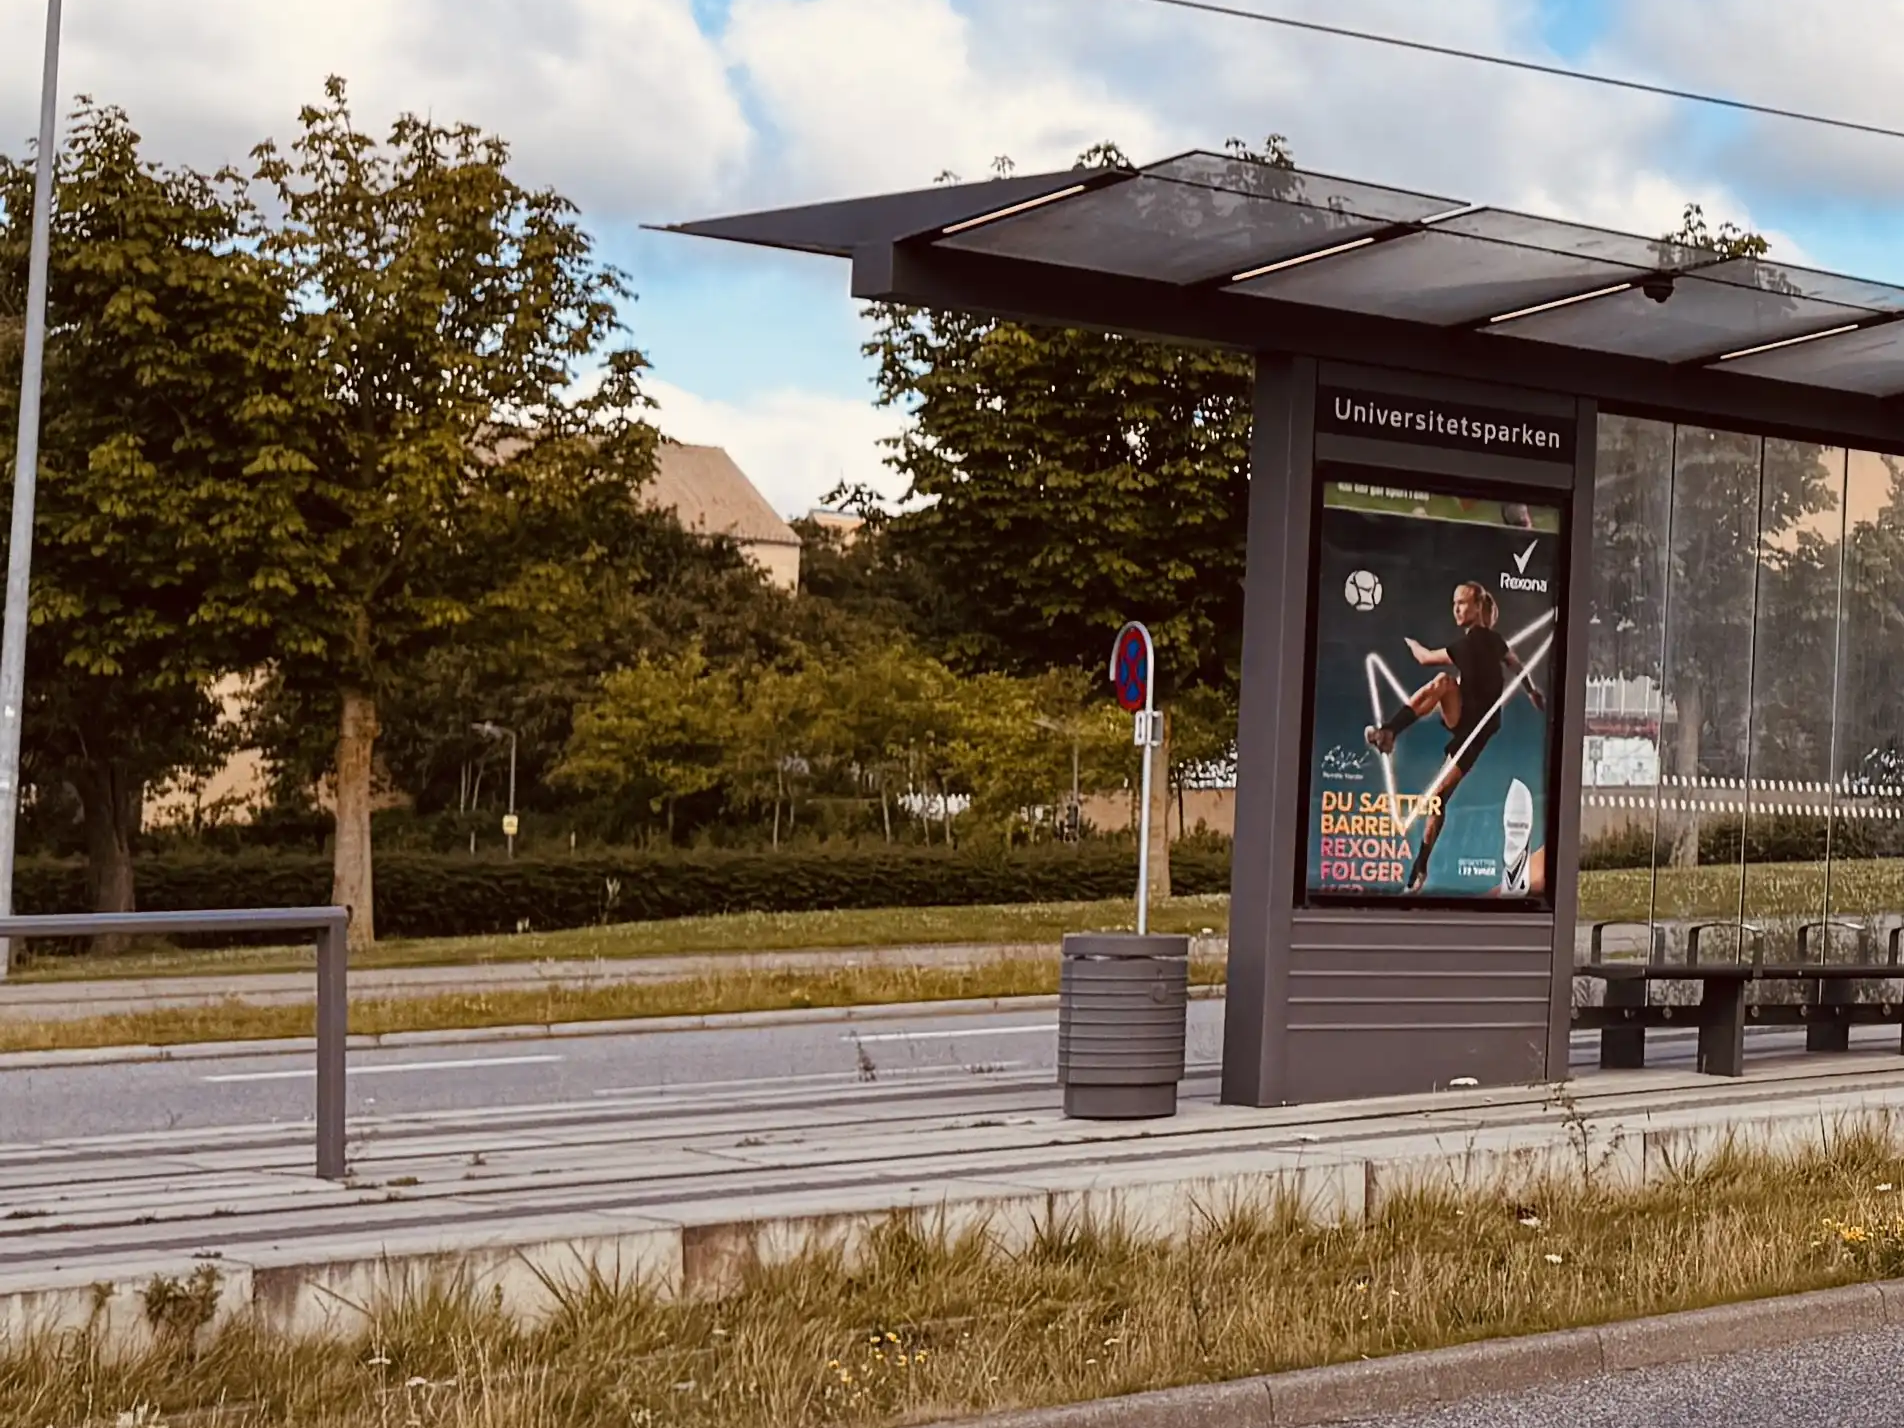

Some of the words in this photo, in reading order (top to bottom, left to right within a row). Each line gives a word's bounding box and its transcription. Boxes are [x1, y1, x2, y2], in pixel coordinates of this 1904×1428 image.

[1335, 397, 1560, 448] Universitetsparken
[1500, 572, 1547, 592] Rexona
[1322, 791, 1353, 812] DU
[1321, 814, 1406, 837] BARREN
[1321, 838, 1413, 859] REXONA
[1320, 860, 1404, 882] FØLGER
